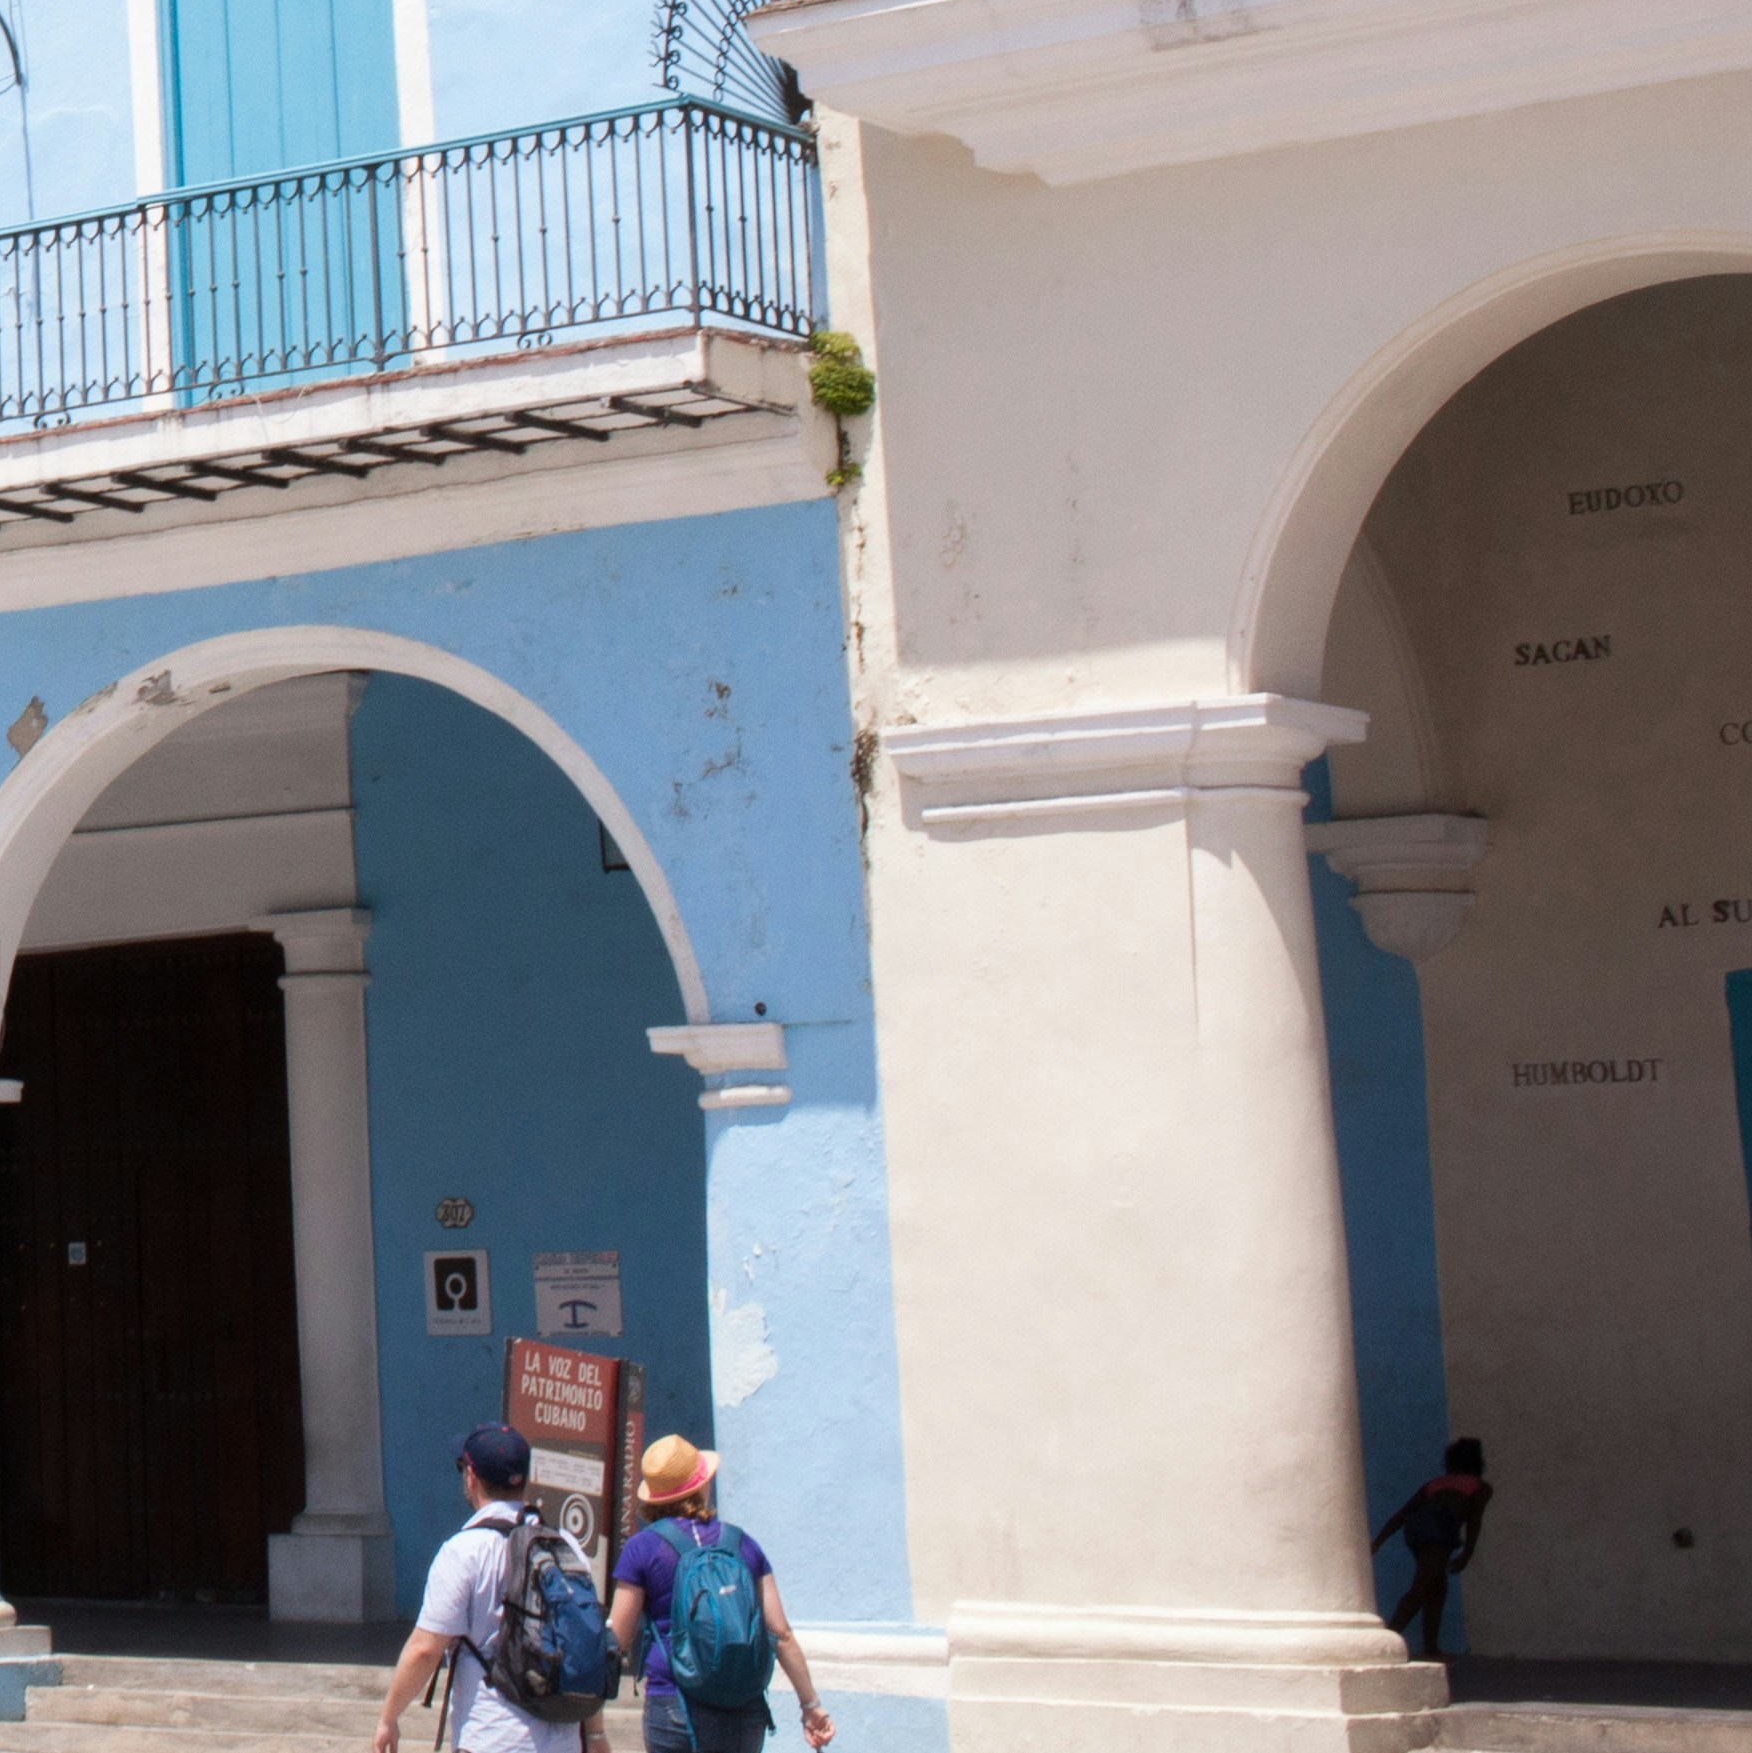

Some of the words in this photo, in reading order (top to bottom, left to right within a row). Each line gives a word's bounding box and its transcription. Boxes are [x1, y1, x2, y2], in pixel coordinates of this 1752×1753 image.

[1568, 481, 1683, 515] EUDOXO
[1514, 635, 1612, 666] SAGAN
[1657, 903, 1700, 928] AL
[1512, 1058, 1663, 1087] HUMBOLDT
[524, 1350, 540, 1373] LA
[548, 1355, 571, 1379] VOZ
[578, 1362, 602, 1386] DEL
[521, 1375, 603, 1411] PATRIMONIO
[534, 1401, 586, 1432] CUBANO
